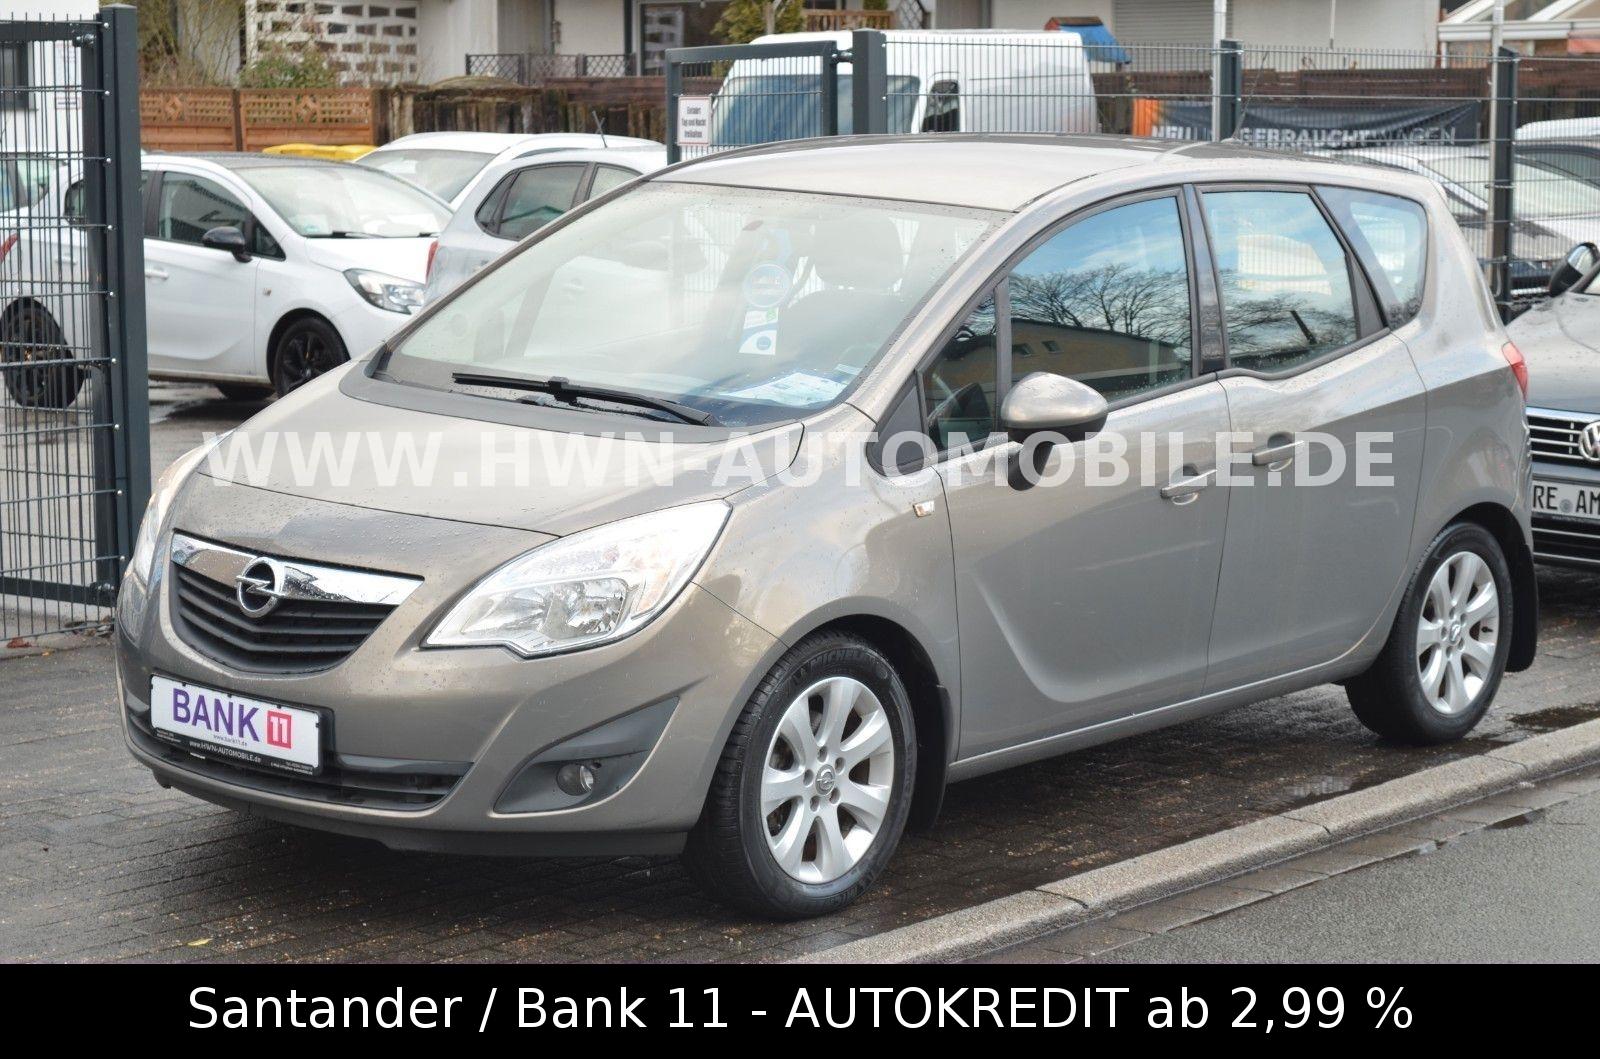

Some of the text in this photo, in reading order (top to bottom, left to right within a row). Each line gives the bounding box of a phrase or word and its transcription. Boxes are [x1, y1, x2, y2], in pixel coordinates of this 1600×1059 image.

[1533, 485, 1600, 515] RE AM
[173, 688, 288, 744] BANK 11
